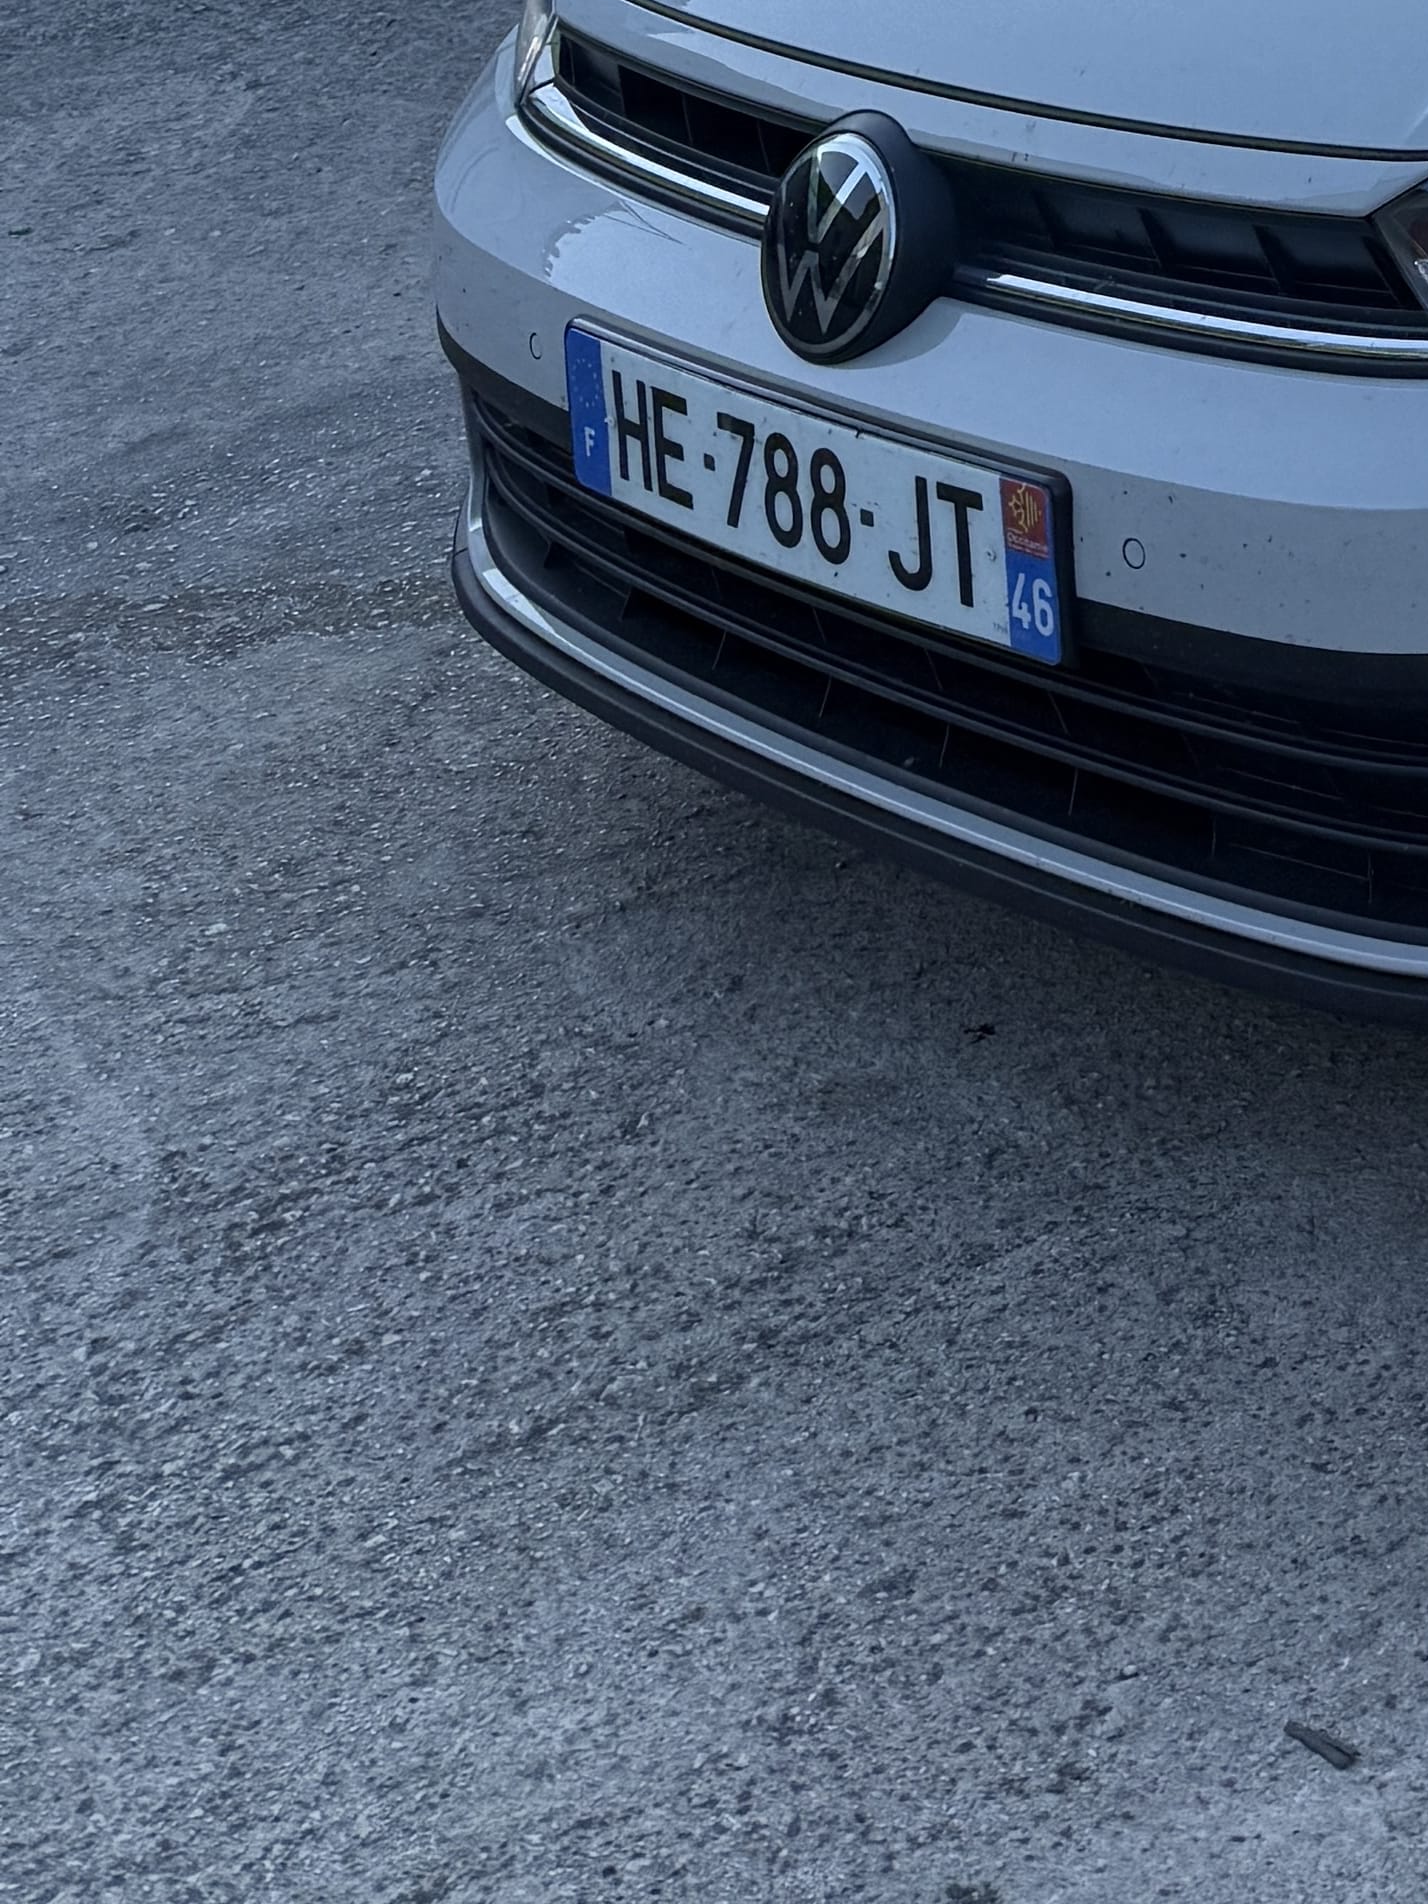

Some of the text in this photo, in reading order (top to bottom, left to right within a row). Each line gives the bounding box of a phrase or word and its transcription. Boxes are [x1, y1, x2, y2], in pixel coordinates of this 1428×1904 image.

[584, 425, 596, 457] F
[612, 369, 984, 609] HE-788-JT
[1012, 572, 1054, 637] 46
